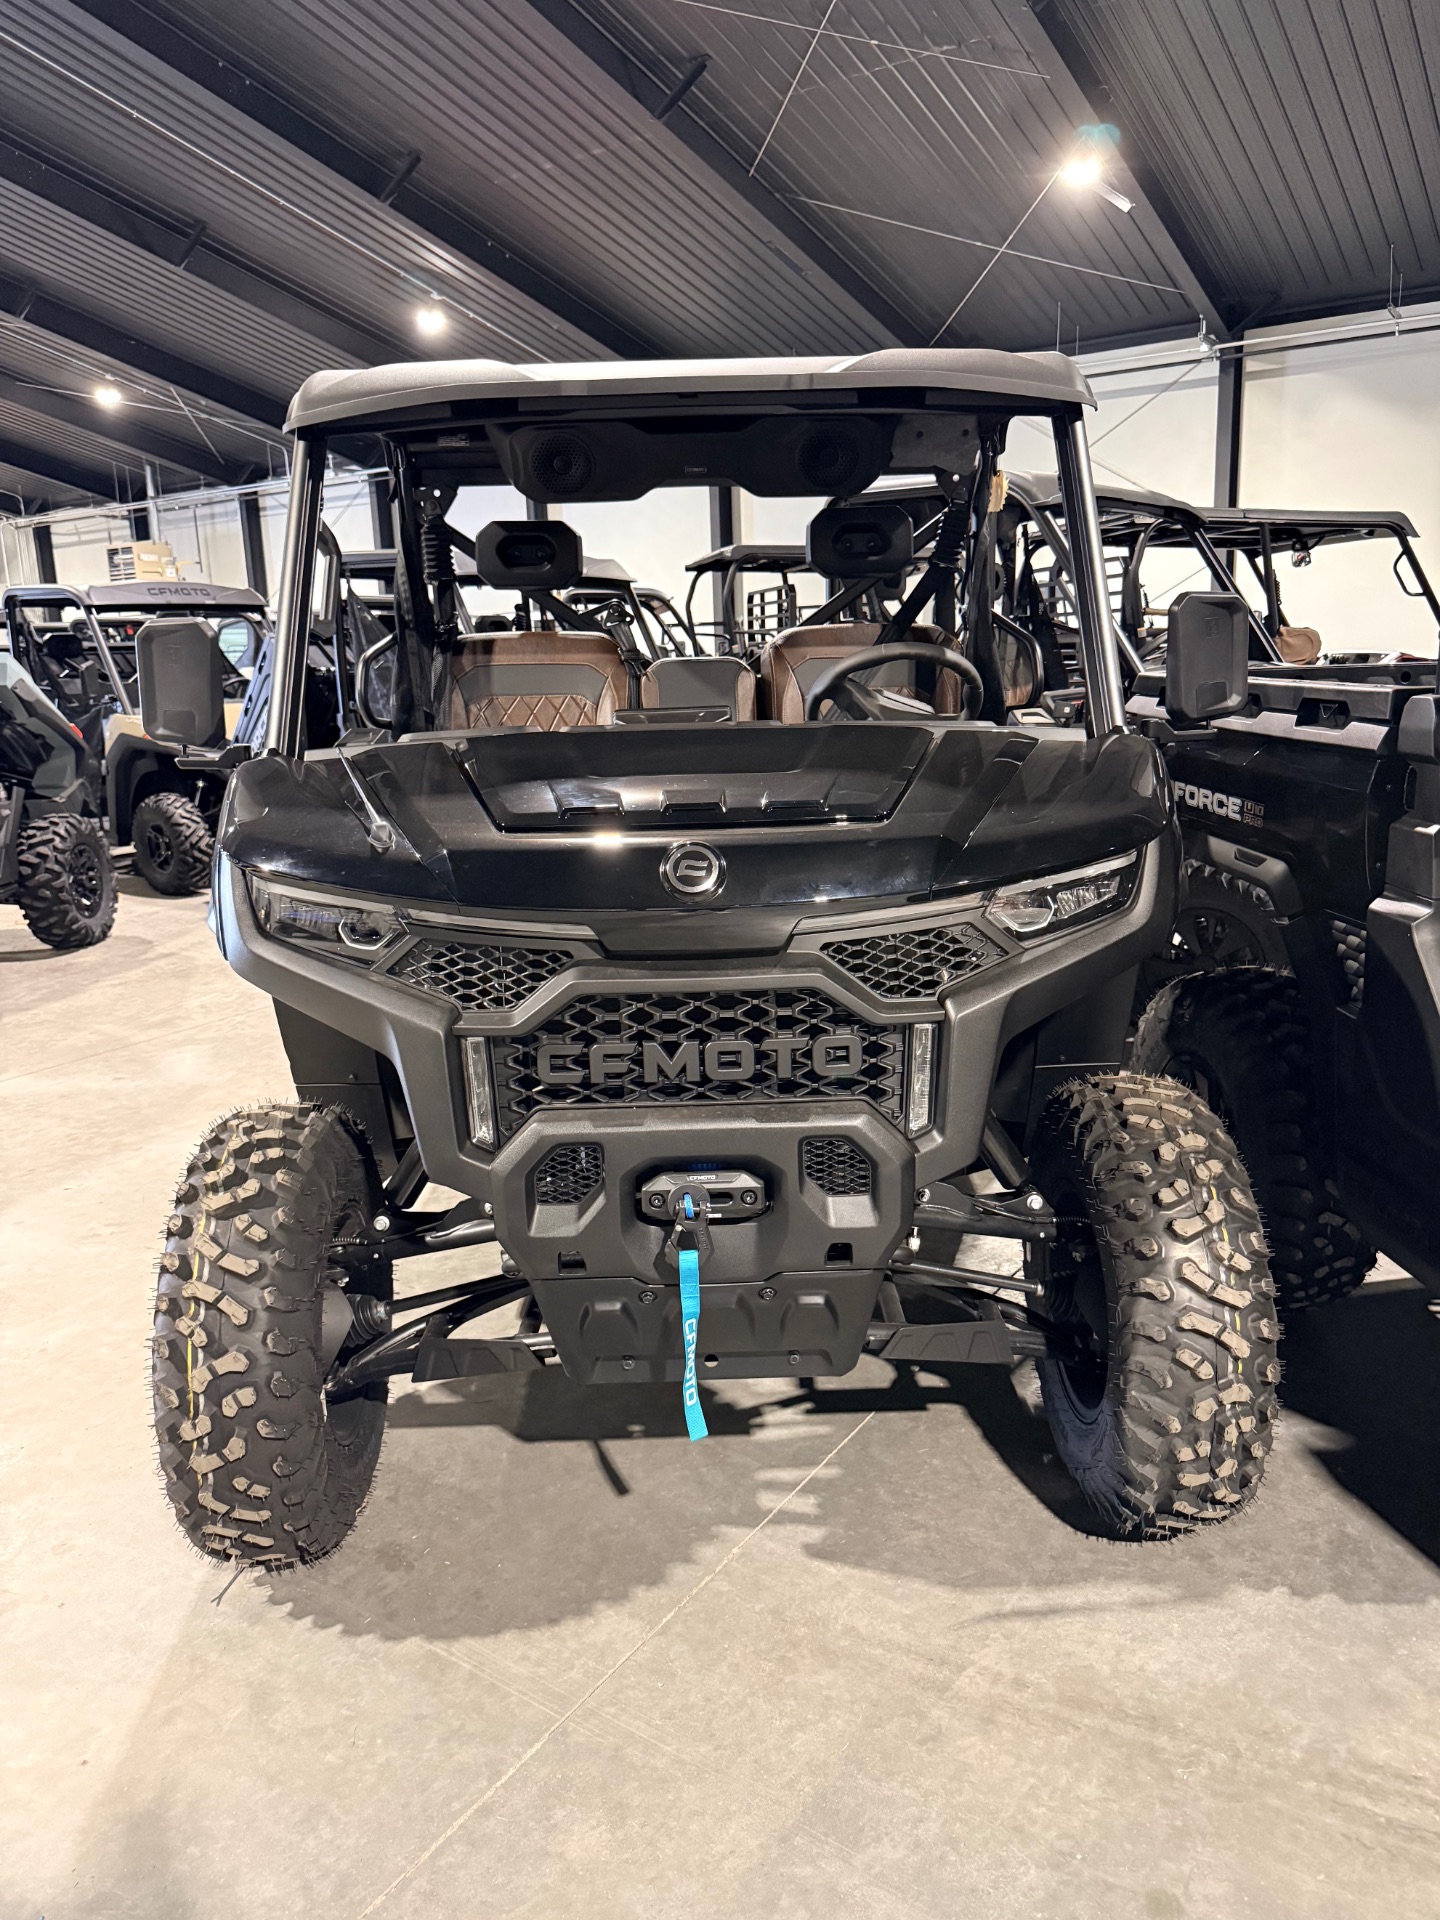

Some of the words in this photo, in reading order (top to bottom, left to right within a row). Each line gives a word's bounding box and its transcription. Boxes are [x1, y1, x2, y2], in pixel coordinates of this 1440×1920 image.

[147, 587, 211, 597] CFMOTO
[537, 1034, 863, 1084] CFMOTO
[684, 1318, 697, 1407] CFMOTO
